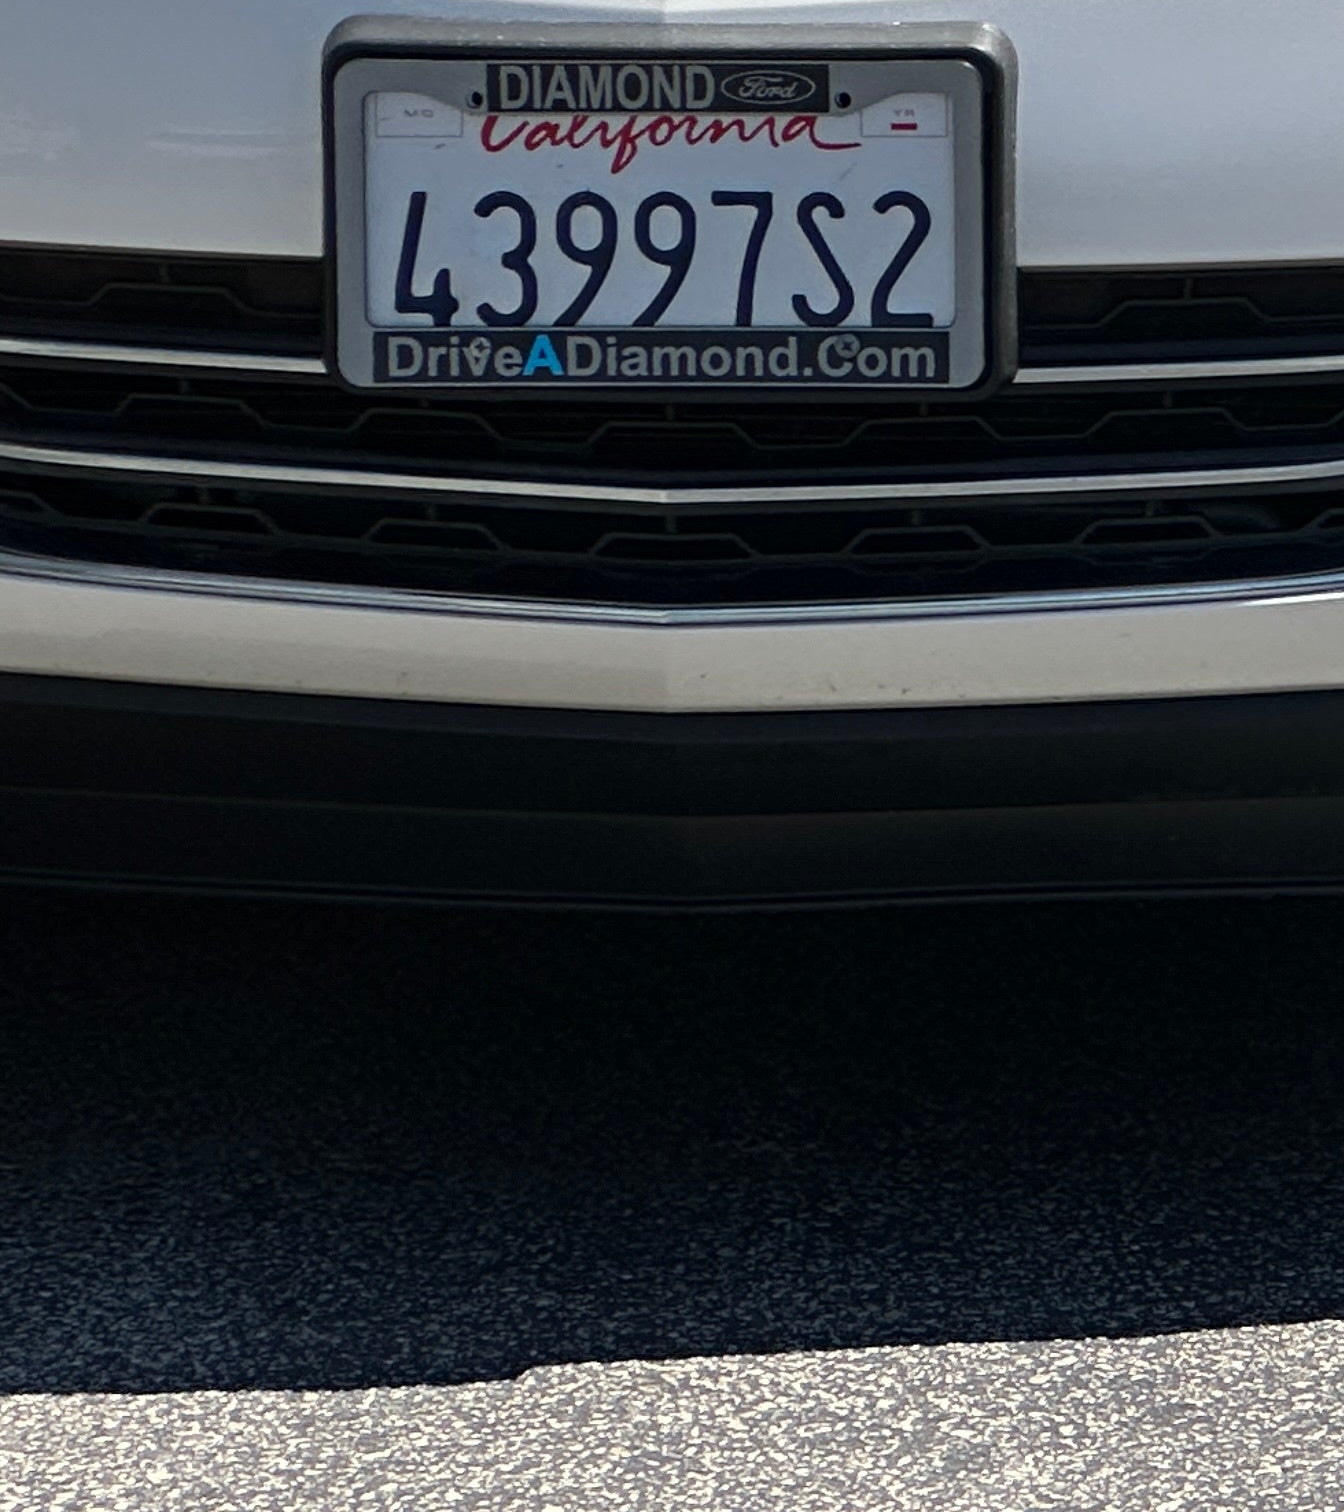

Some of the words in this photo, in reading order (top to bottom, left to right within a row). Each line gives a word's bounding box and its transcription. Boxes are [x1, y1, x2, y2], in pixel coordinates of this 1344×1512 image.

[500, 64, 715, 110] DIAMOND
[737, 76, 798, 100] Ford
[480, 114, 861, 174] California
[394, 190, 934, 327] 43997S2
[387, 333, 936, 378] DriveADiamond.Com
